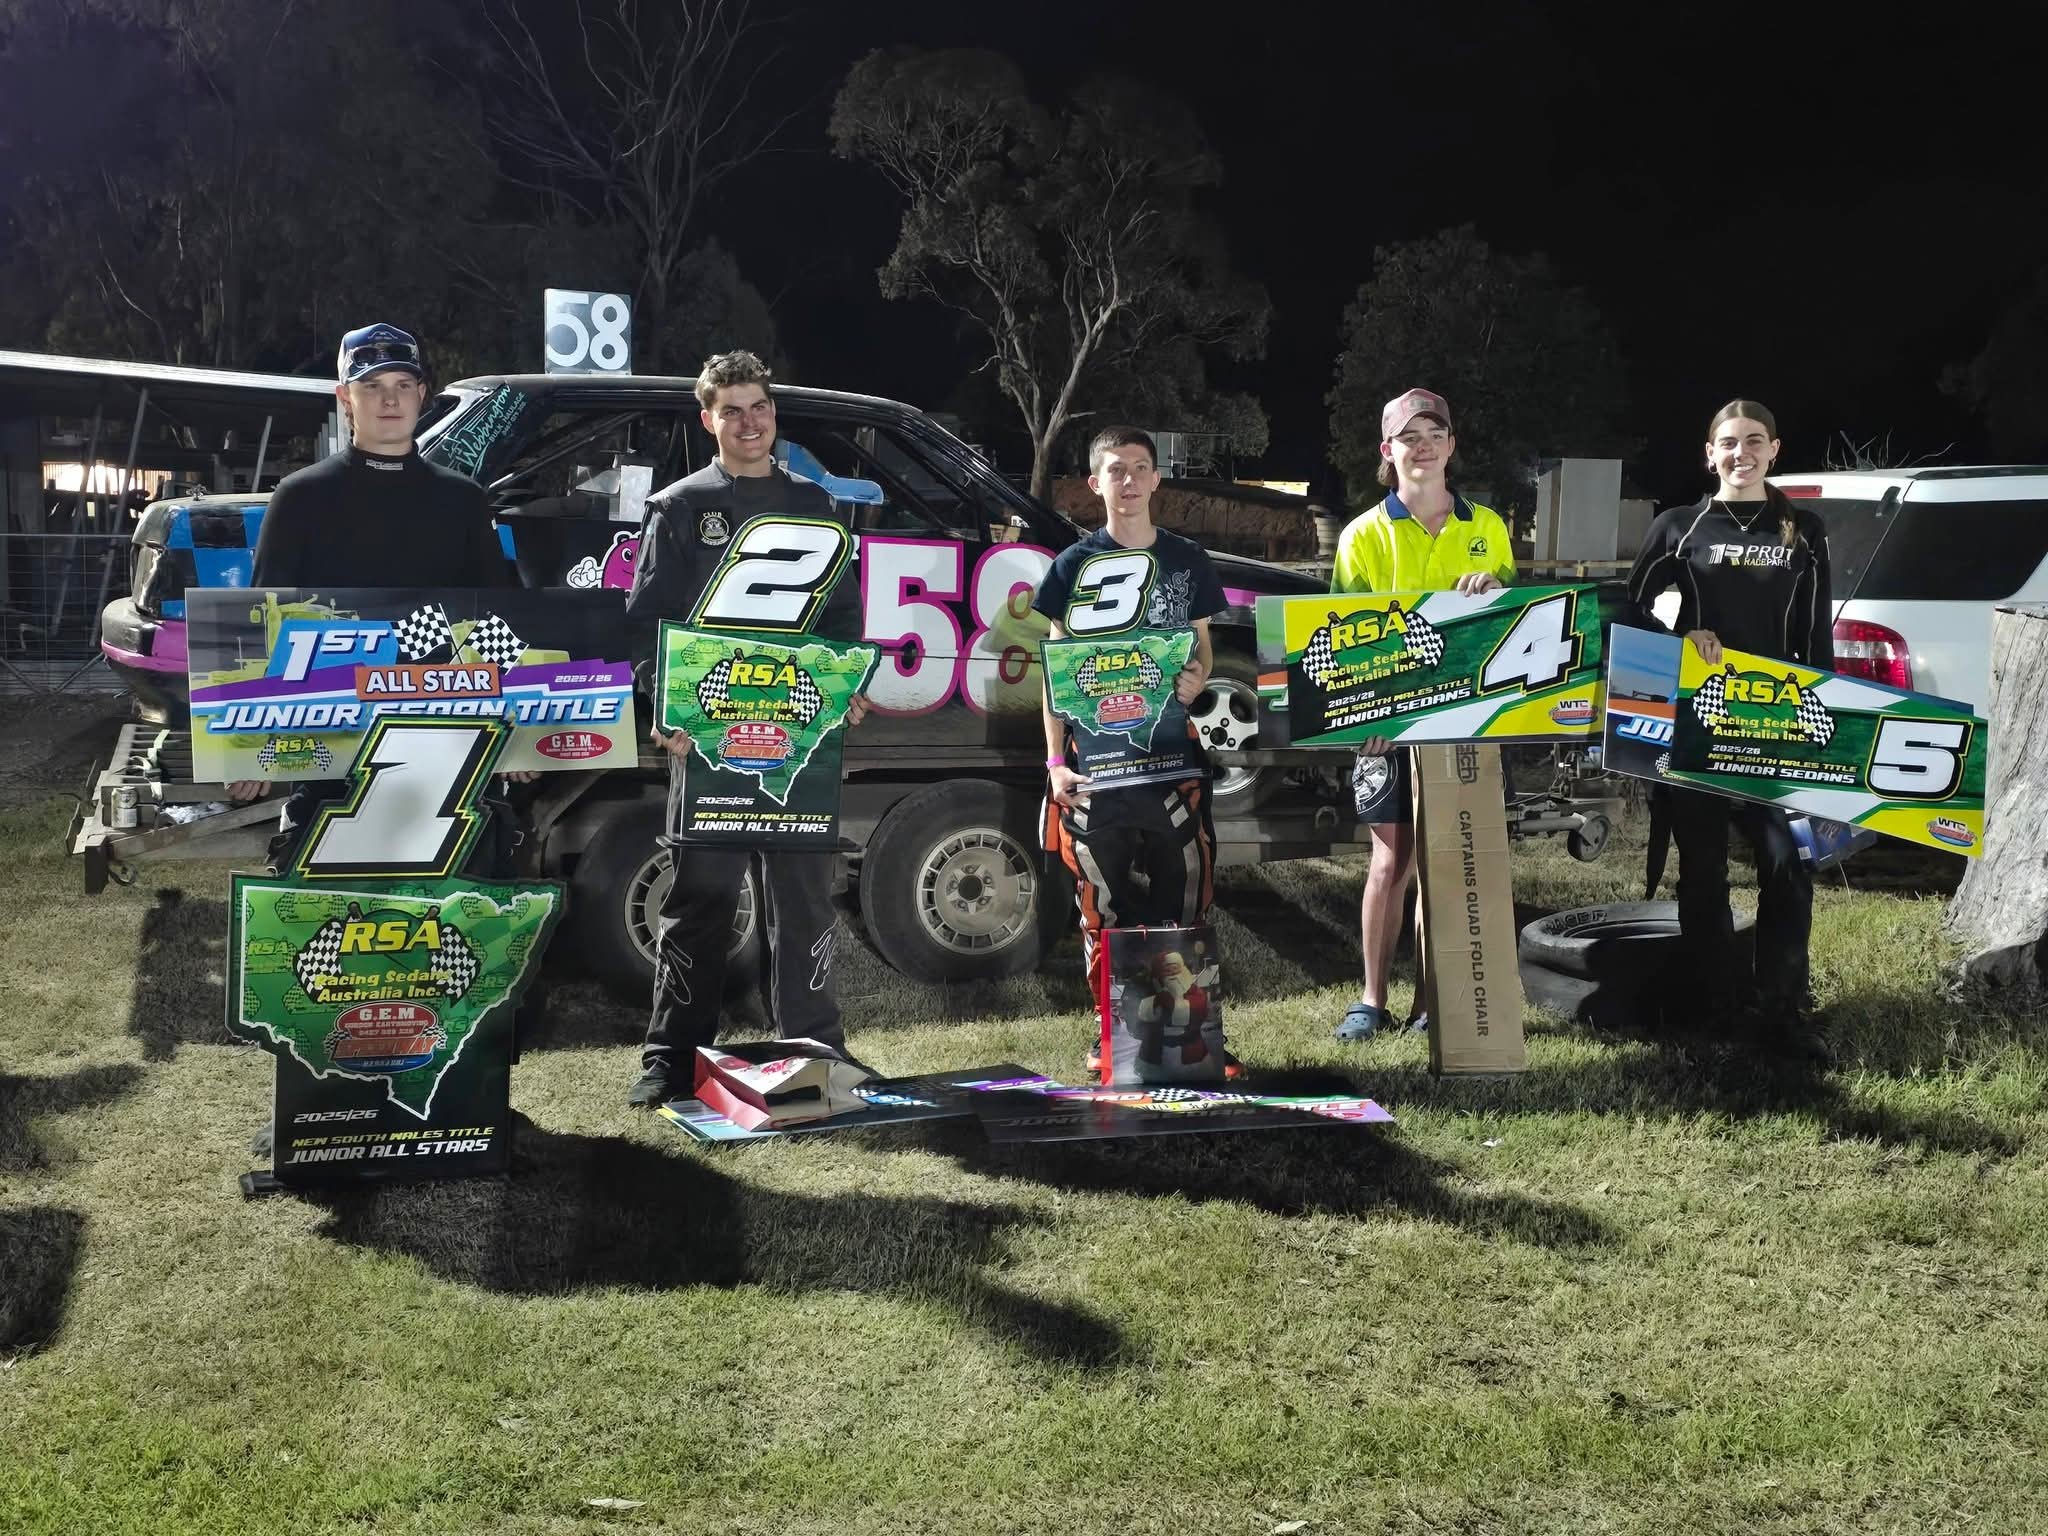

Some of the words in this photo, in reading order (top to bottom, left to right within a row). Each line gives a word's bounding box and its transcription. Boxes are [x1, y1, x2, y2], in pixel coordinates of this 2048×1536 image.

[546, 292, 630, 370] 58
[702, 523, 840, 622] 2
[1069, 555, 1150, 630] 3
[861, 536, 1058, 717] 58
[1331, 611, 1410, 651] RSA
[282, 629, 389, 681] 1ST
[1483, 597, 1574, 688] 4
[727, 663, 797, 687] RSA
[1095, 651, 1142, 672] RSA
[1318, 661, 1369, 682] Racing
[1373, 647, 1425, 665] Sedans
[366, 671, 417, 692] ALL
[423, 670, 492, 691] STAR
[1326, 668, 1391, 692] Australia
[1394, 662, 1421, 674] Inc.
[710, 697, 755, 710] Racing
[758, 700, 800, 710] Sedans
[1324, 708, 1349, 719] NEW
[1350, 696, 1391, 712] SOUTH
[1393, 685, 1434, 701] WALES
[1437, 677, 1472, 691] TITLE
[1560, 700, 1588, 708] WTC
[1724, 678, 1803, 706] RSA
[210, 703, 361, 729] JUNIOR
[517, 698, 619, 720] TITLE
[711, 710, 769, 720] Australia
[773, 711, 796, 720] Inc.
[1324, 706, 1391, 730] JUNIOR
[1396, 687, 1471, 713] SEDANS
[1706, 713, 1759, 728] Racing
[1763, 717, 1817, 732] Sedans
[275, 738, 315, 753] RSA
[1712, 726, 1780, 740] Australia
[1783, 730, 1810, 742] Inc.
[1090, 768, 1124, 779] JUNIOR
[1126, 765, 1146, 773] ALL
[1148, 759, 1184, 770] STARS
[1708, 753, 1734, 762] NEW
[1735, 756, 1777, 765] SOUTH
[1779, 759, 1819, 769] WALES
[1822, 763, 1857, 773] TITLE
[1868, 719, 1966, 793] 5
[1706, 761, 1776, 776] JUNIOR
[1779, 768, 1856, 784] SEDANS
[309, 727, 482, 864] 1
[689, 821, 743, 831] JUNIOR
[746, 822, 774, 832] ALL
[777, 823, 829, 833] STARS
[694, 812, 718, 820] NEW
[1458, 810, 1477, 888] CAPTAINS
[1467, 892, 1481, 936] QUAD
[339, 920, 442, 953] RSA
[1472, 941, 1485, 981] FOLD
[314, 973, 380, 986] Racing
[385, 969, 450, 983] Sedans
[317, 987, 403, 1002] Australia
[407, 985, 441, 997] Inc.
[1474, 986, 1489, 1037] CHAIR
[285, 1146, 365, 1164] JUNIOR
[368, 1143, 410, 1157] ALL
[414, 1138, 491, 1154] STARS
[292, 1138, 329, 1148] NEW
[330, 1133, 387, 1145] SOUTH
[389, 1130, 445, 1142] WALES
[448, 1126, 496, 1137] TITLE
